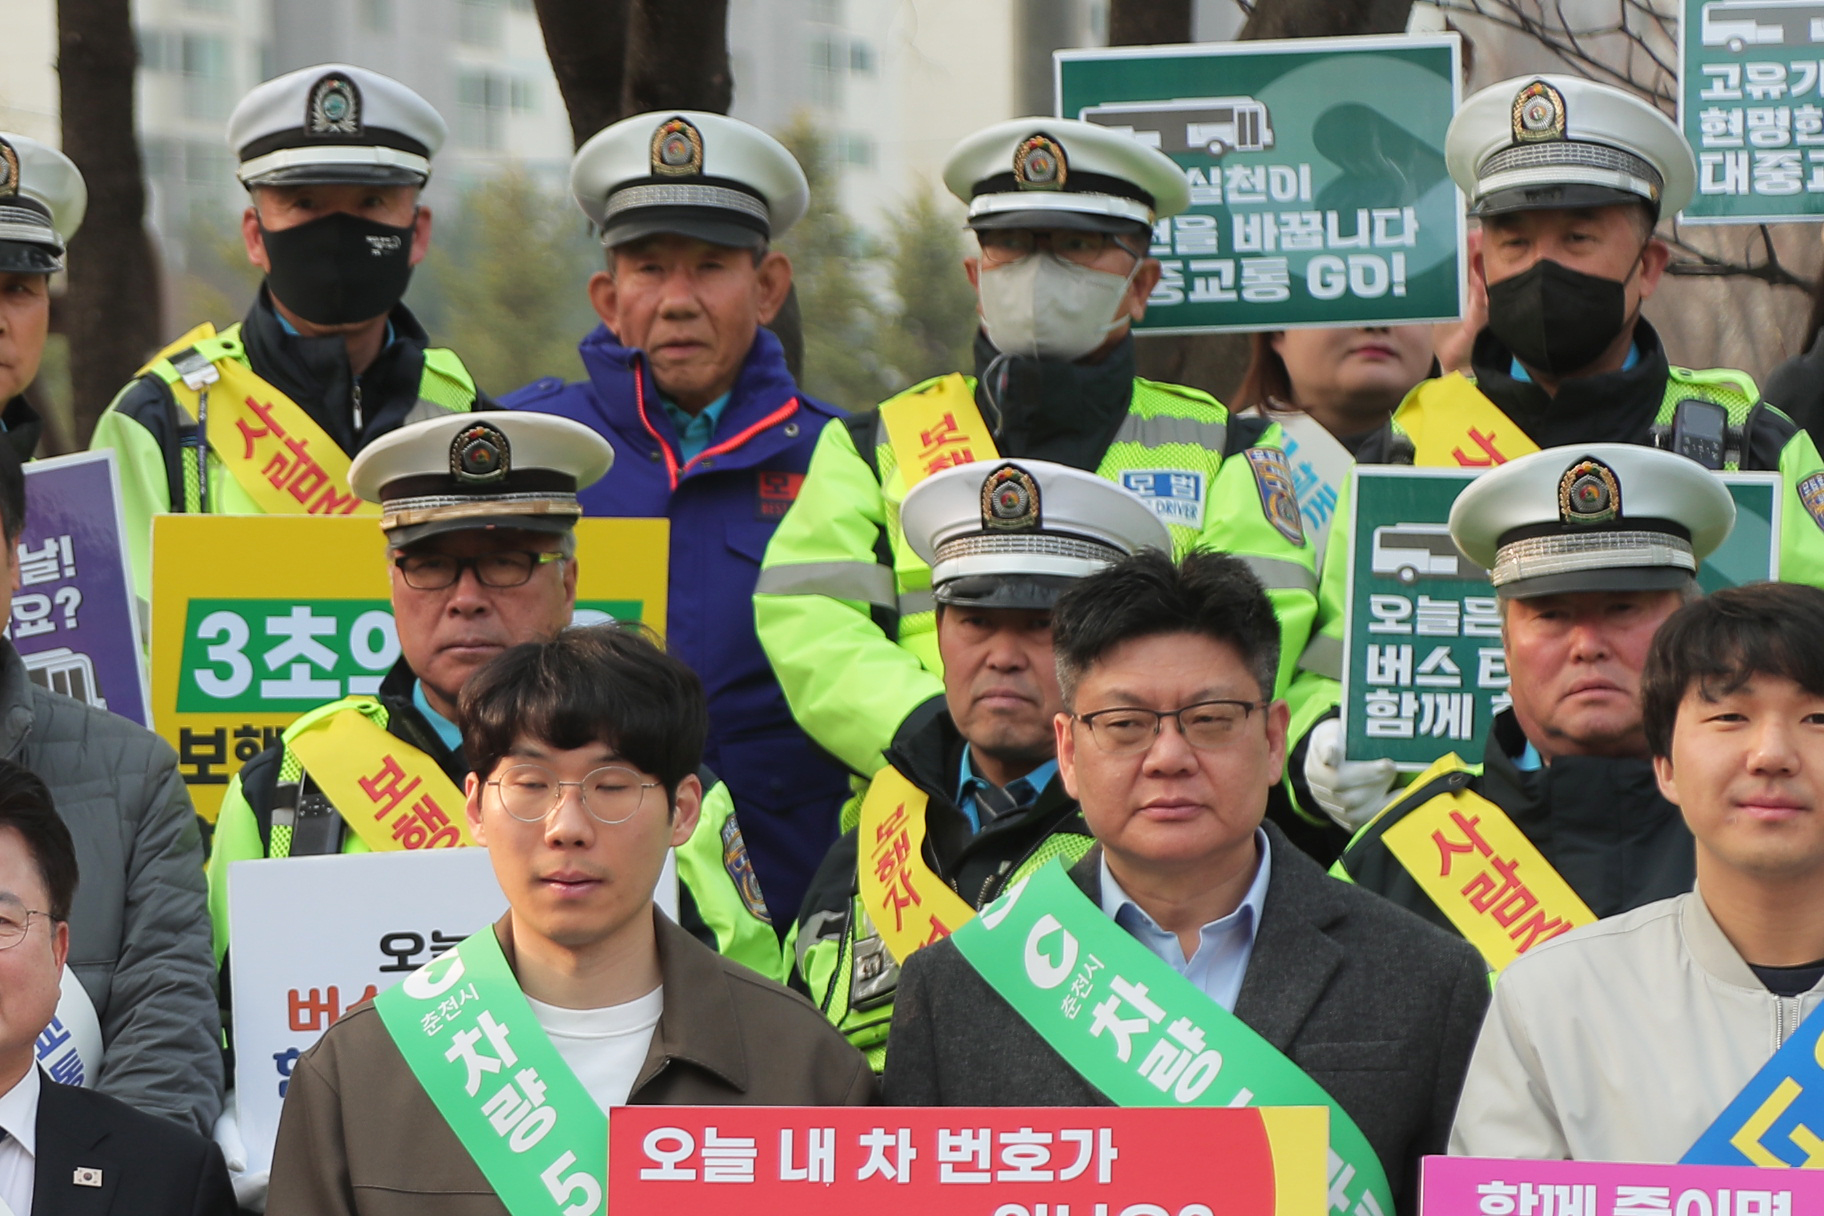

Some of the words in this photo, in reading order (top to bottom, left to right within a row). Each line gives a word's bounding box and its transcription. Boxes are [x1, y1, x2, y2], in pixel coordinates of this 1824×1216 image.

[1232, 206, 1419, 253] 바꿉니다
[1147, 256, 1291, 307] 중교통
[1306, 251, 1407, 301] GO!
[1157, 500, 1198, 522] DRIVER
[4, 585, 83, 639] 요?
[1365, 643, 1462, 689] 버스
[1364, 687, 1474, 742] 함께
[420, 981, 481, 1038] 춘천시
[1060, 952, 1106, 1021] 춘천시
[1088, 973, 1224, 1104] 차량
[444, 1009, 558, 1155] 차량
[639, 1126, 759, 1184] 오늘
[778, 1127, 837, 1186] 내
[857, 1126, 917, 1185] 차
[936, 1126, 1119, 1185] 번호가
